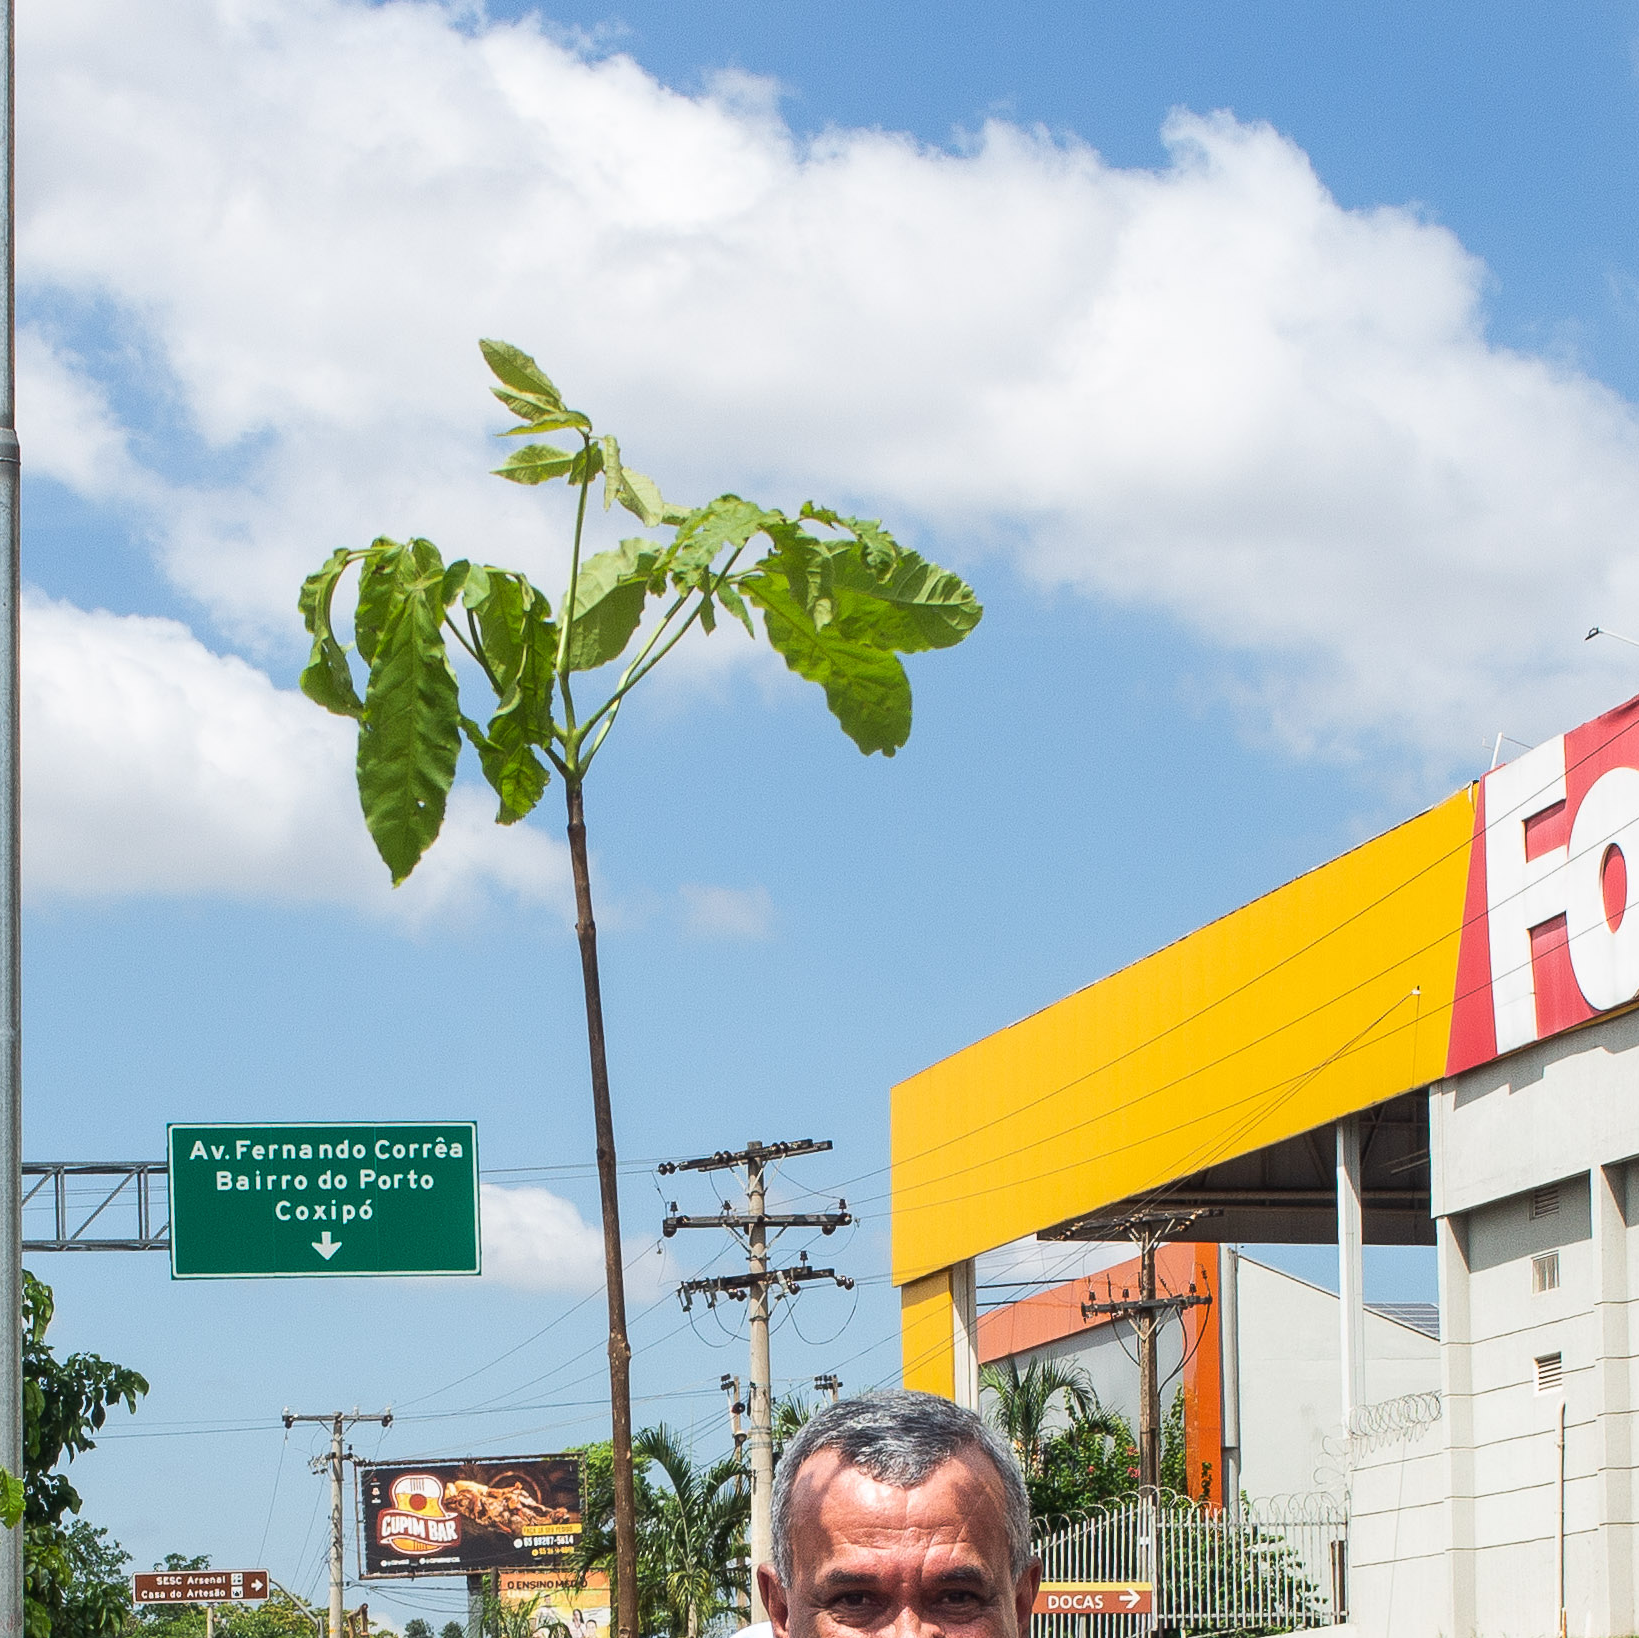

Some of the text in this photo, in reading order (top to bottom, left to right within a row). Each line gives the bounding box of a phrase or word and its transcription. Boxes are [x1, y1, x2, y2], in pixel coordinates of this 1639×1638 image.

[188, 1136, 464, 1161] Av. Fernando Corrêa
[215, 1169, 435, 1191] Bairro do Porto
[274, 1199, 374, 1225] Coxipó
[380, 1515, 459, 1542] CUPIM BAR
[155, 1575, 226, 1586] SESC Arsenal
[507, 1580, 515, 1590] O
[516, 1580, 554, 1590] ENSINO
[141, 1588, 226, 1599] Casa do Artesão
[1047, 1594, 1104, 1610] DOCAS
